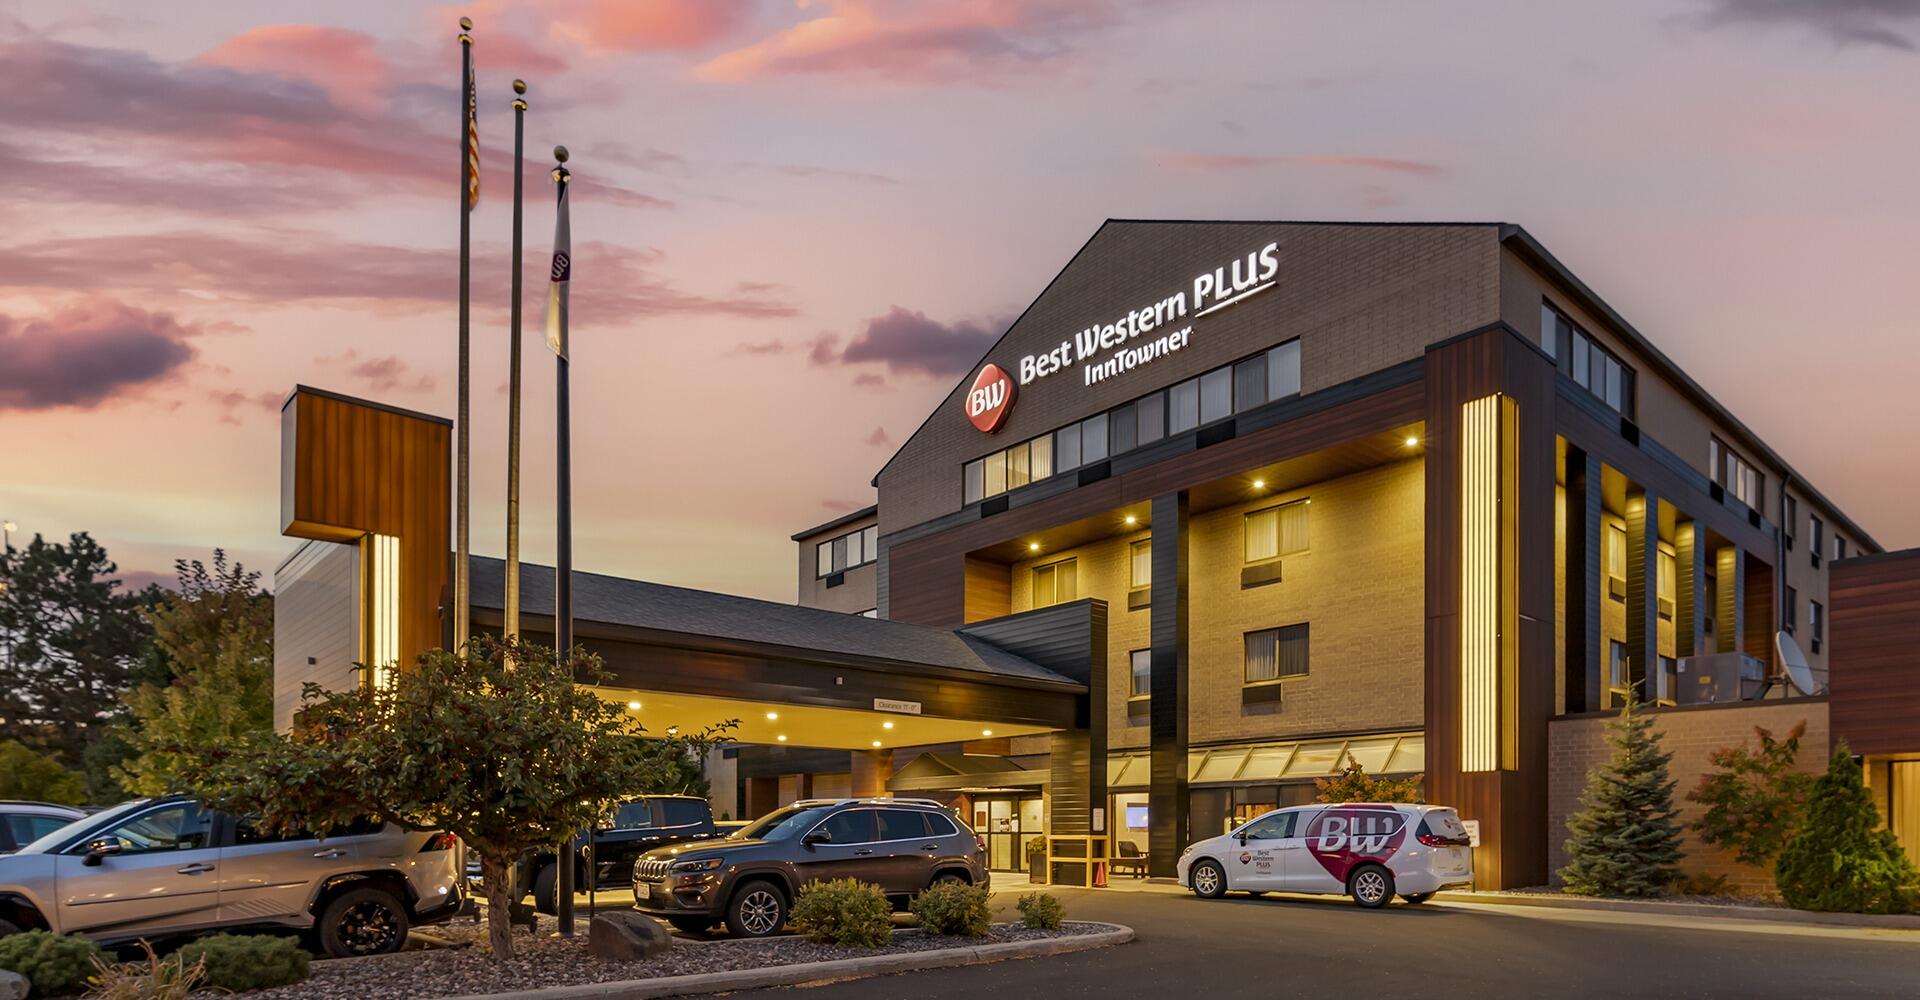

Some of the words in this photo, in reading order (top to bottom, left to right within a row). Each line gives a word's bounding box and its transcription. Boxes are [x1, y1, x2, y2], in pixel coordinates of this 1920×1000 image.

[1020, 340, 1072, 385] Best
[1075, 291, 1187, 361] Western
[1194, 242, 1278, 309] PLUS
[1084, 326, 1193, 387] InnTowner
[971, 379, 1005, 417] BW
[1317, 816, 1393, 853] BW
